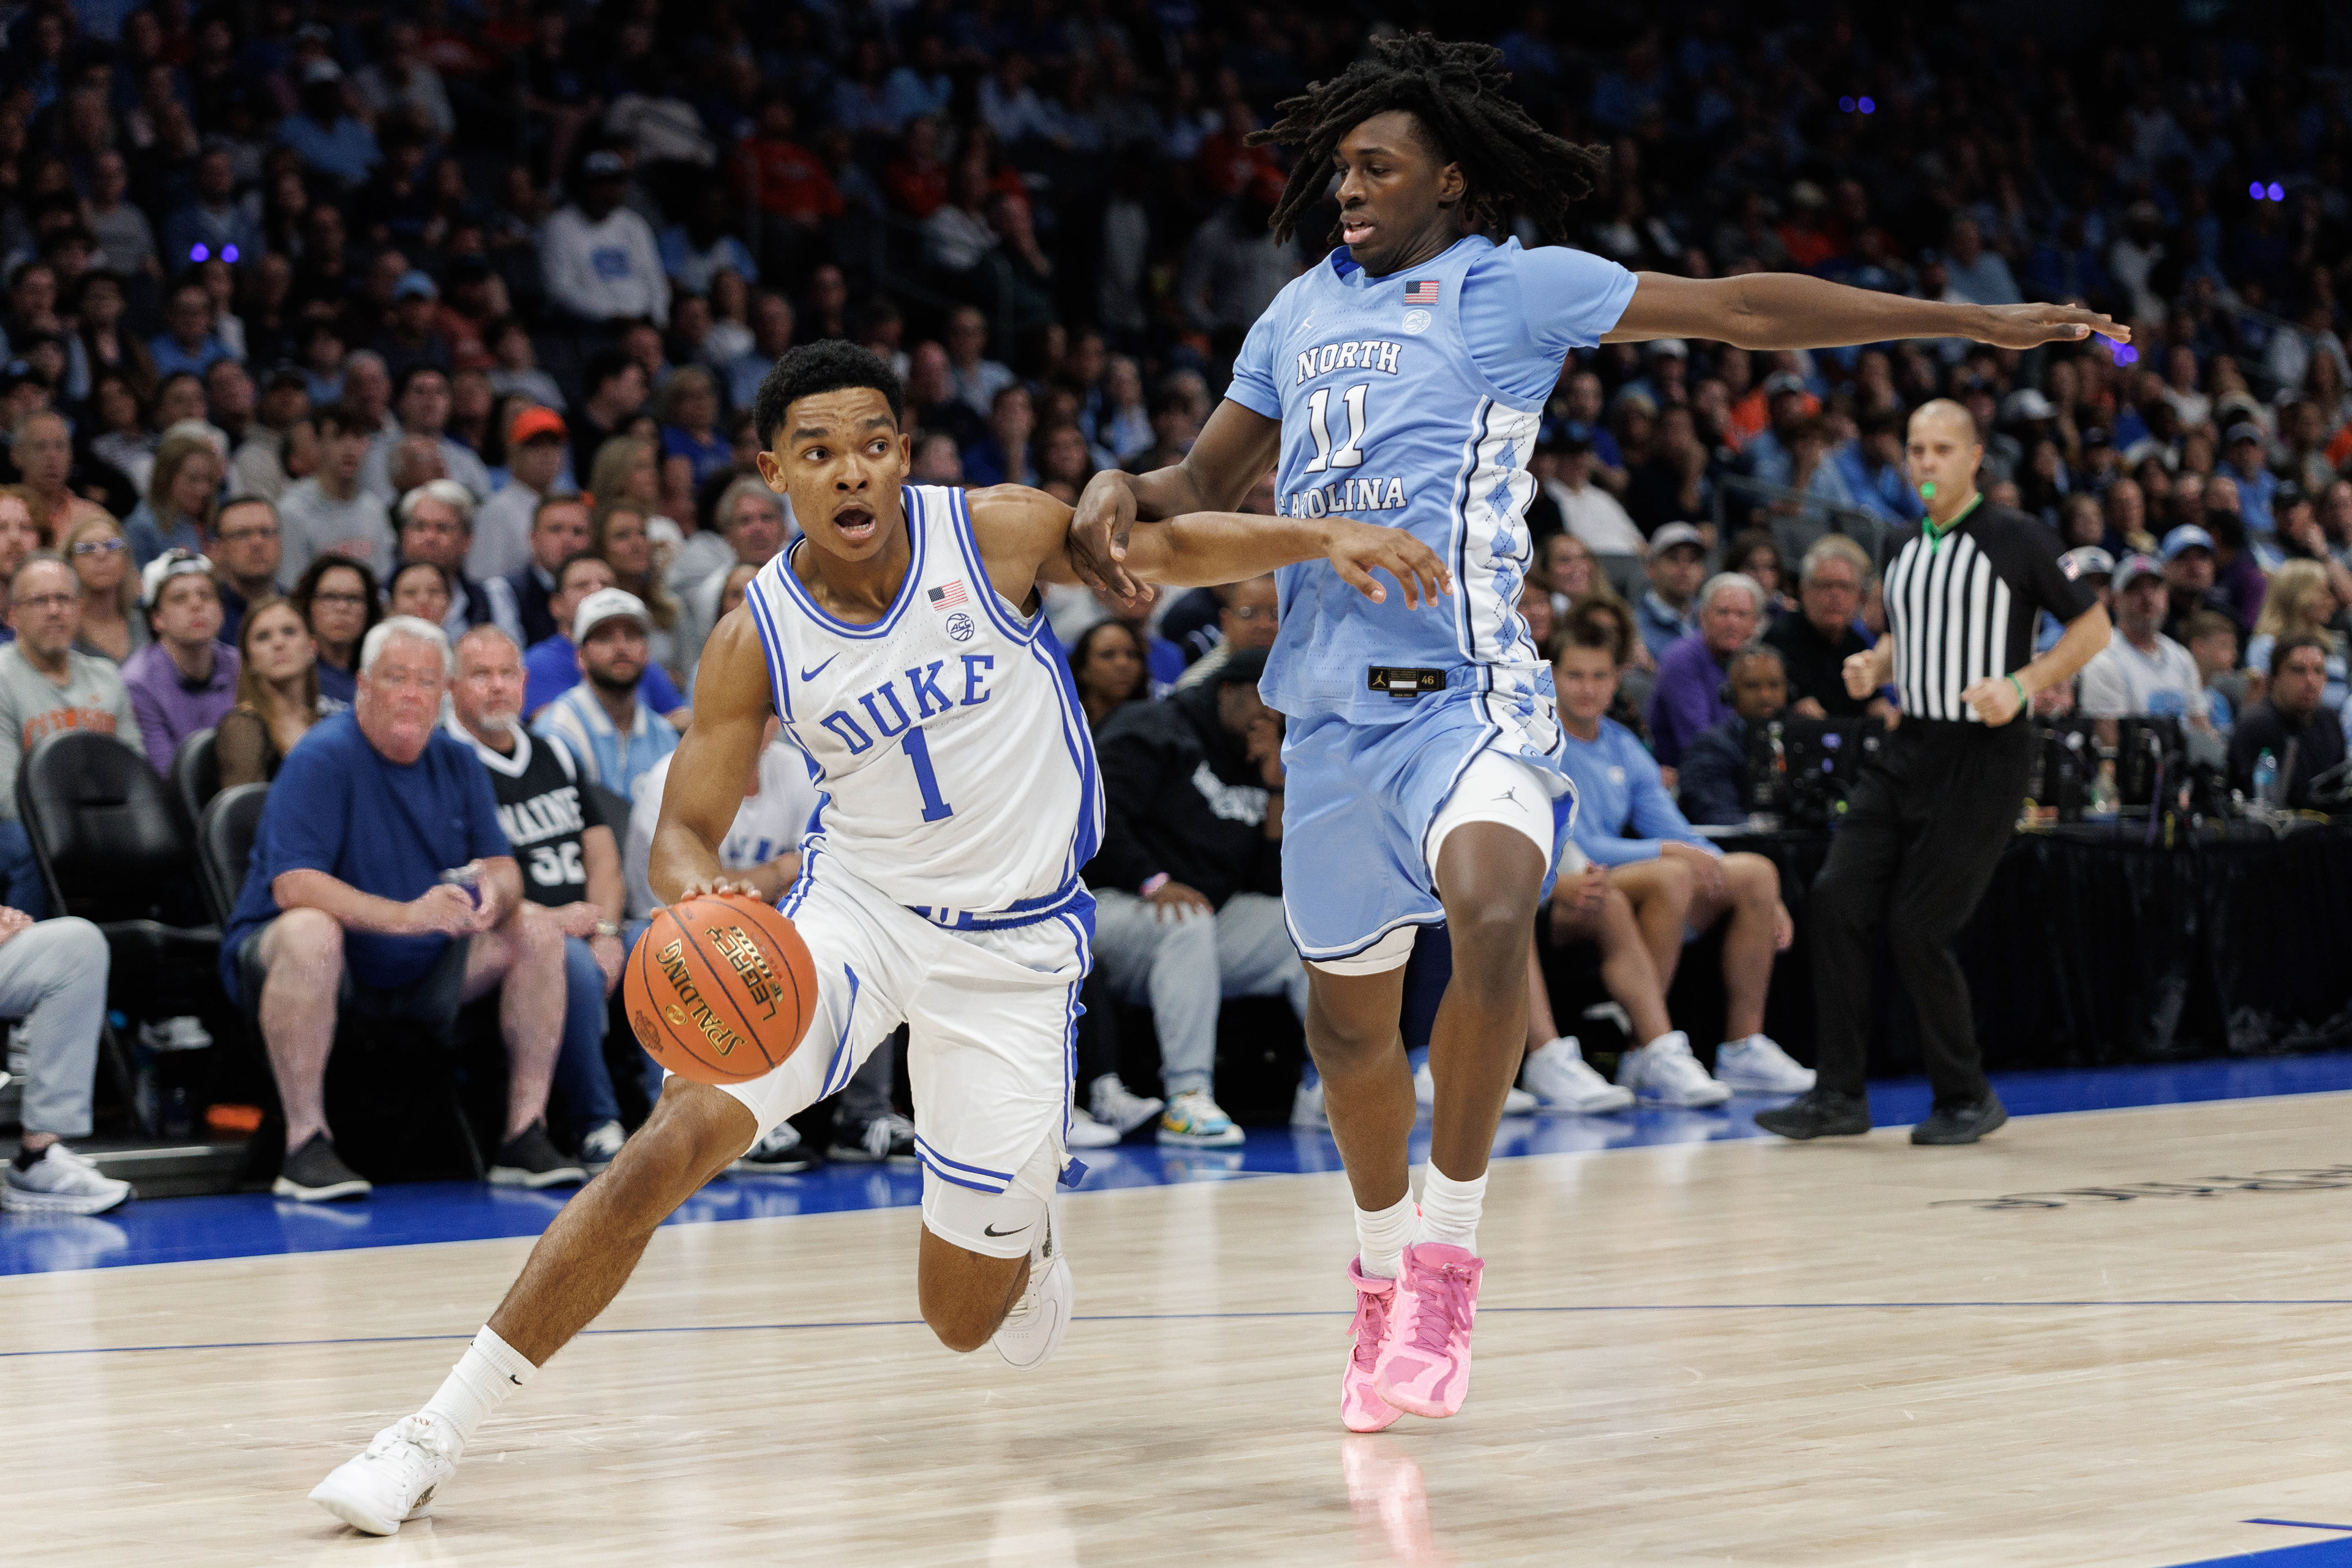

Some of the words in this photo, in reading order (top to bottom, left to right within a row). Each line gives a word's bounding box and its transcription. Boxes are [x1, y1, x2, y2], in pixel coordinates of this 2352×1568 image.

[1297, 341, 1402, 385] NORTH
[1303, 383, 1370, 474] 11
[951, 619, 971, 632] ACC
[820, 655, 994, 755] DUKE
[1422, 676, 1434, 684] 46
[901, 725, 954, 823] 1
[656, 938, 747, 1057] SPALDING
[704, 926, 777, 1022] LEGACY
